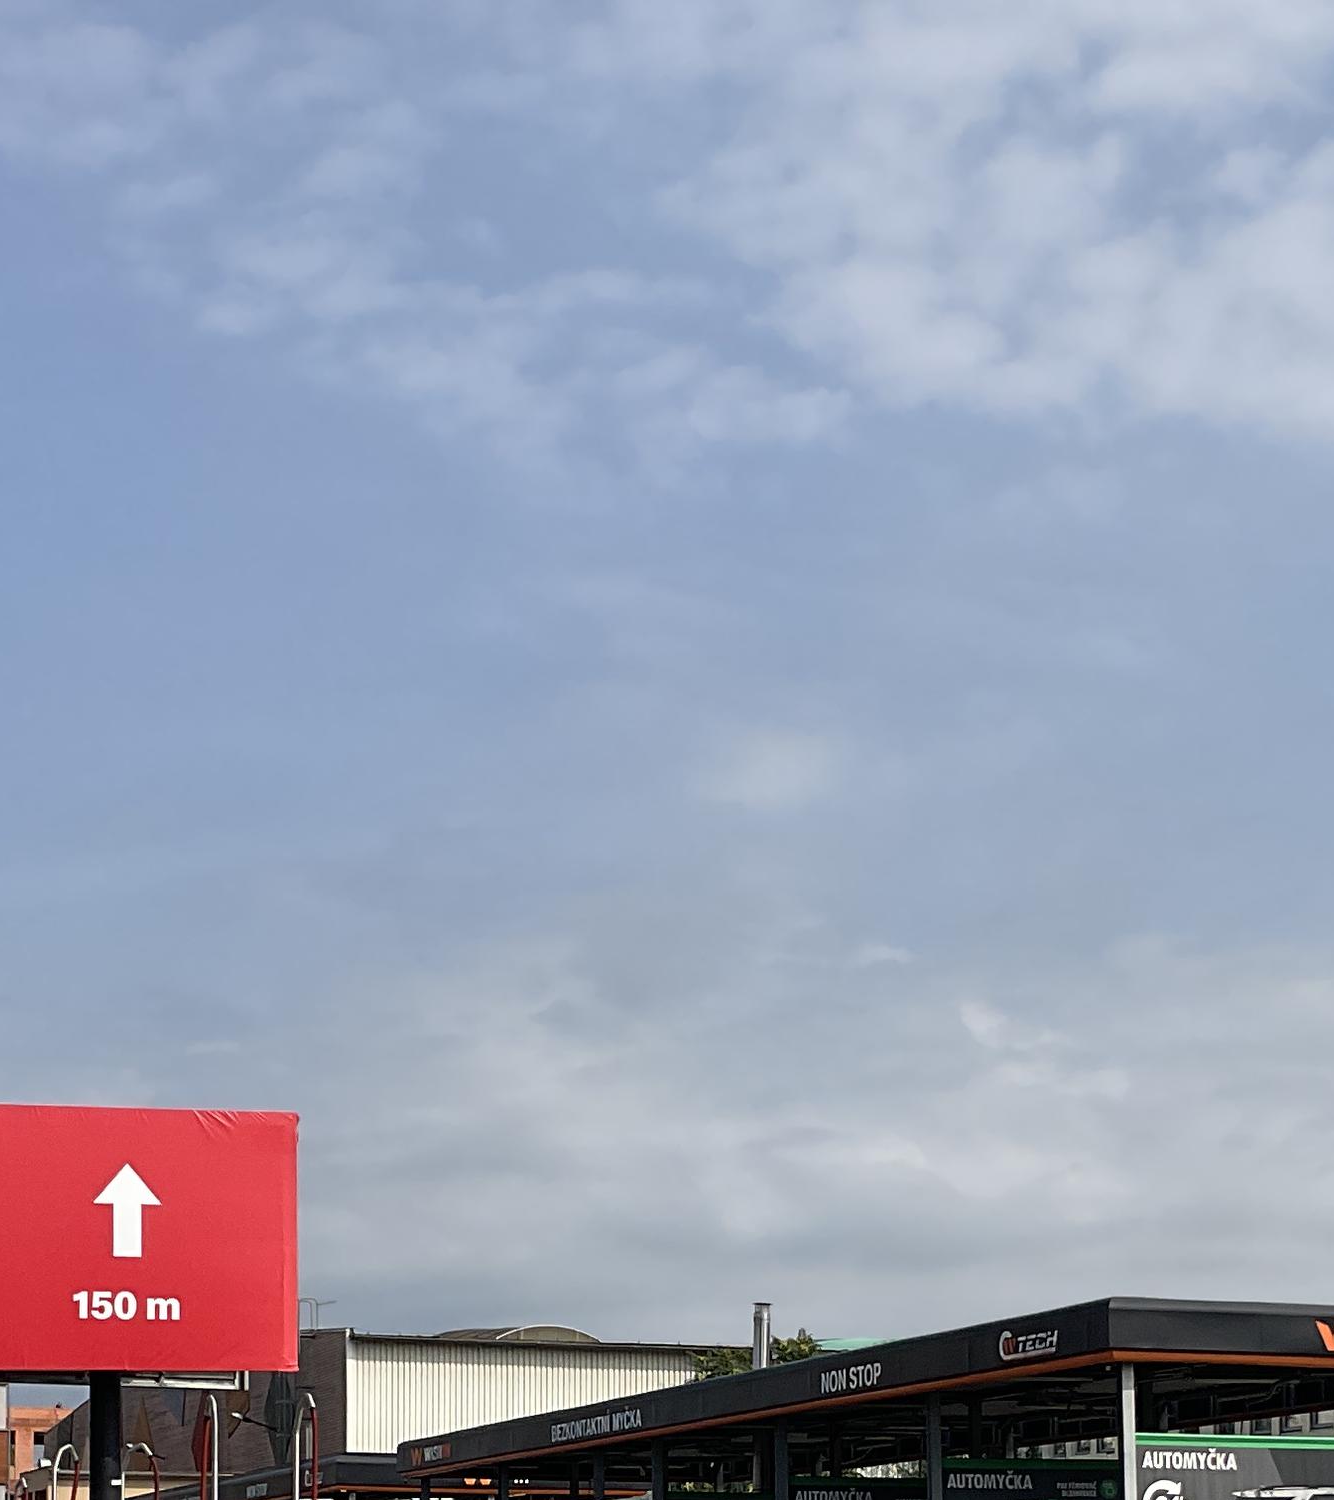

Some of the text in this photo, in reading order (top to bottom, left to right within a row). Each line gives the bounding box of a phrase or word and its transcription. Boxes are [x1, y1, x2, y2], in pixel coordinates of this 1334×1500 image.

[72, 1290, 181, 1321] 150 m
[820, 1362, 882, 1394] NON STOP
[551, 1405, 643, 1443] BEZKONTAKTNÍ MYČKA
[1142, 1448, 1238, 1471] AUTOMYČKA
[947, 1470, 1033, 1490] AUTOMYČKA
